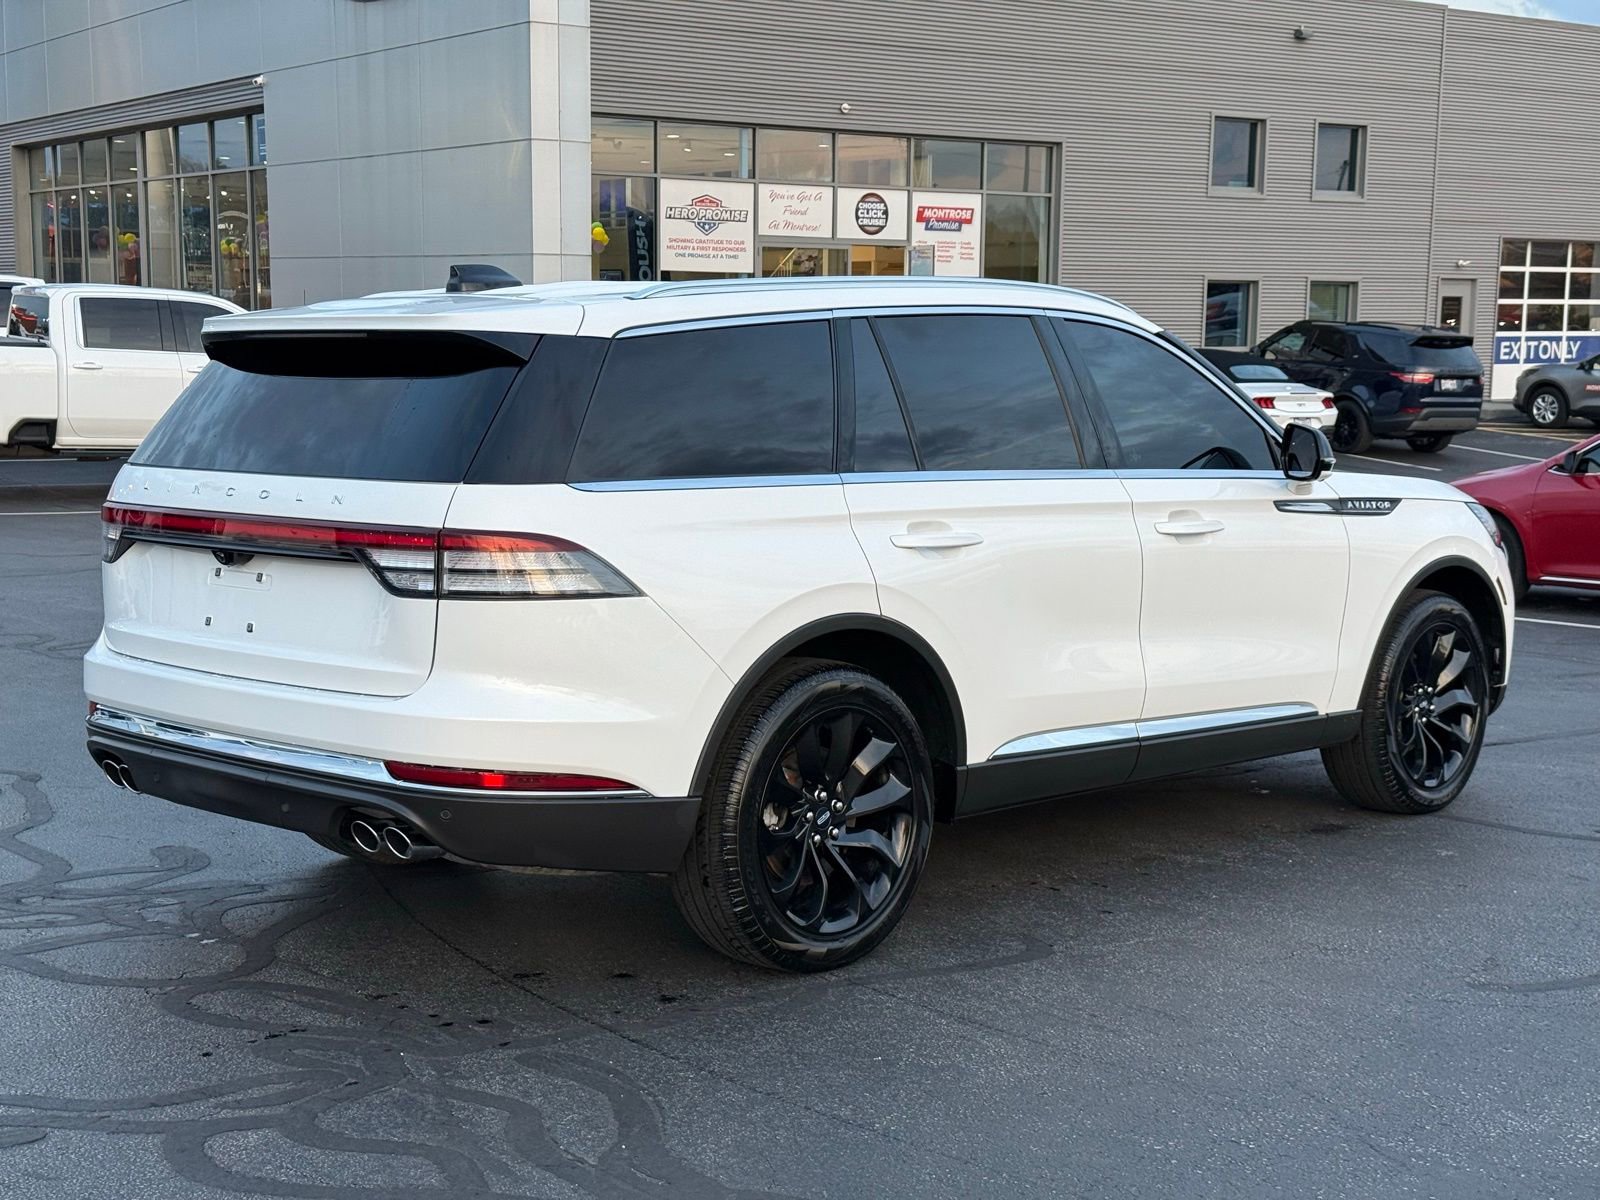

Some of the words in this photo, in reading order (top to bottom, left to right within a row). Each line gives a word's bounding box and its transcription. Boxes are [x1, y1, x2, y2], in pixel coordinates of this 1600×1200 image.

[769, 190, 795, 203] You've
[797, 191, 812, 203] Got
[814, 192, 823, 202] A
[666, 207, 698, 220] HERO
[698, 209, 748, 223] PROMISE
[783, 205, 809, 216] Friend
[923, 208, 973, 220] MONTROSE
[768, 219, 780, 230] At
[928, 218, 959, 230] Promise
[1500, 341, 1538, 360] EXIT
[1539, 340, 1581, 360] ONLY
[143, 480, 345, 505] LINCOLN
[1347, 500, 1391, 509] AVIATOR
